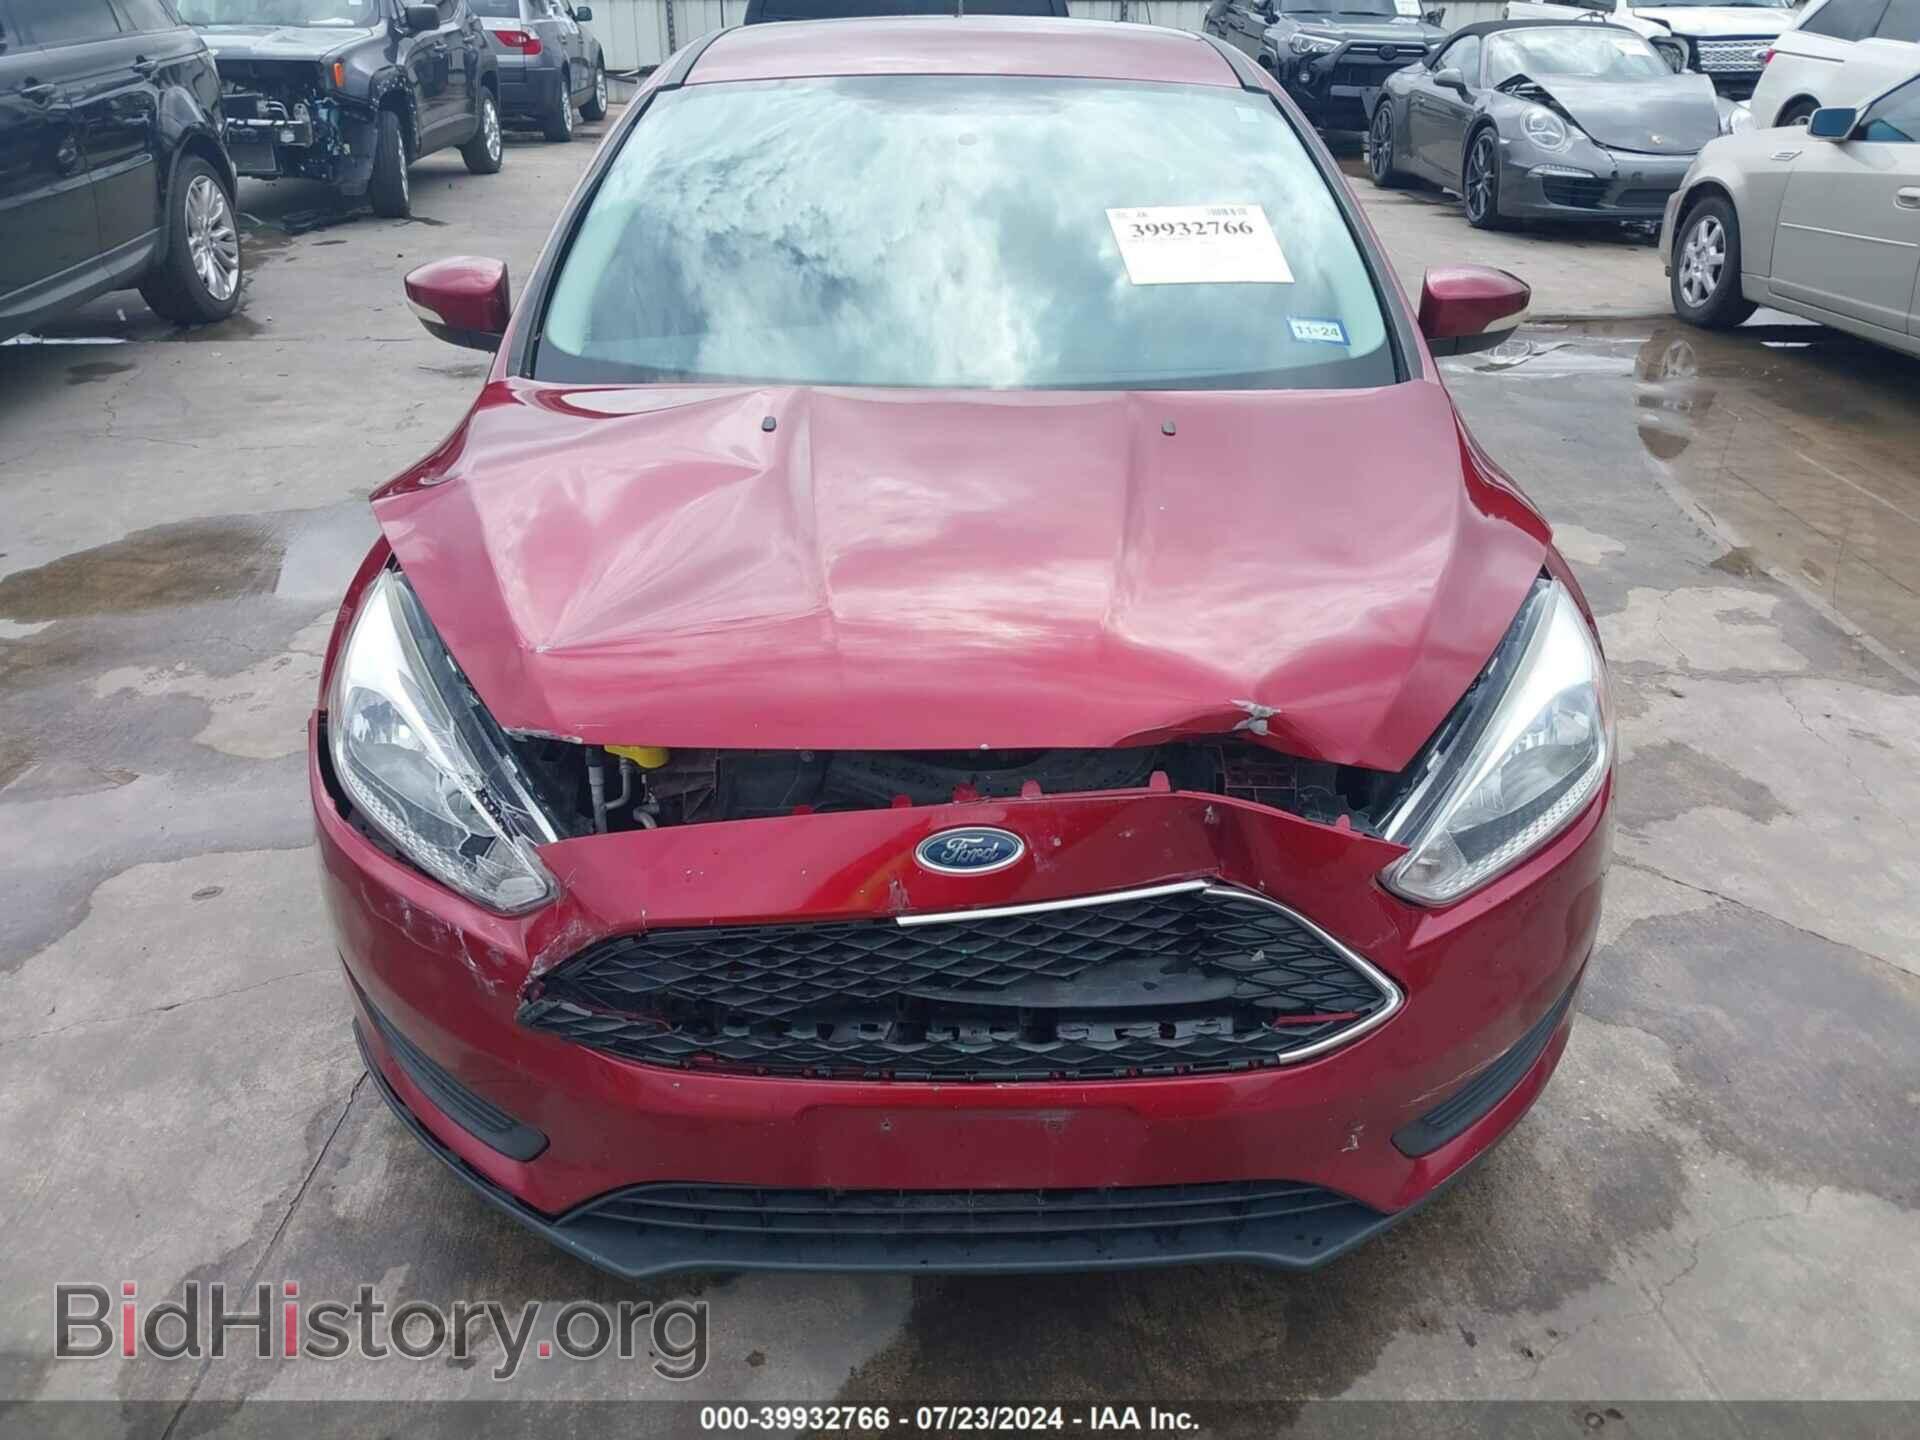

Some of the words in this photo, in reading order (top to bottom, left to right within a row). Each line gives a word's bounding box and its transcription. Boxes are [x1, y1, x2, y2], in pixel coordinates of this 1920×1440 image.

[1131, 220, 1254, 238] 39932766
[1295, 325, 1340, 337] 11-24
[941, 837, 1000, 863] Ford
